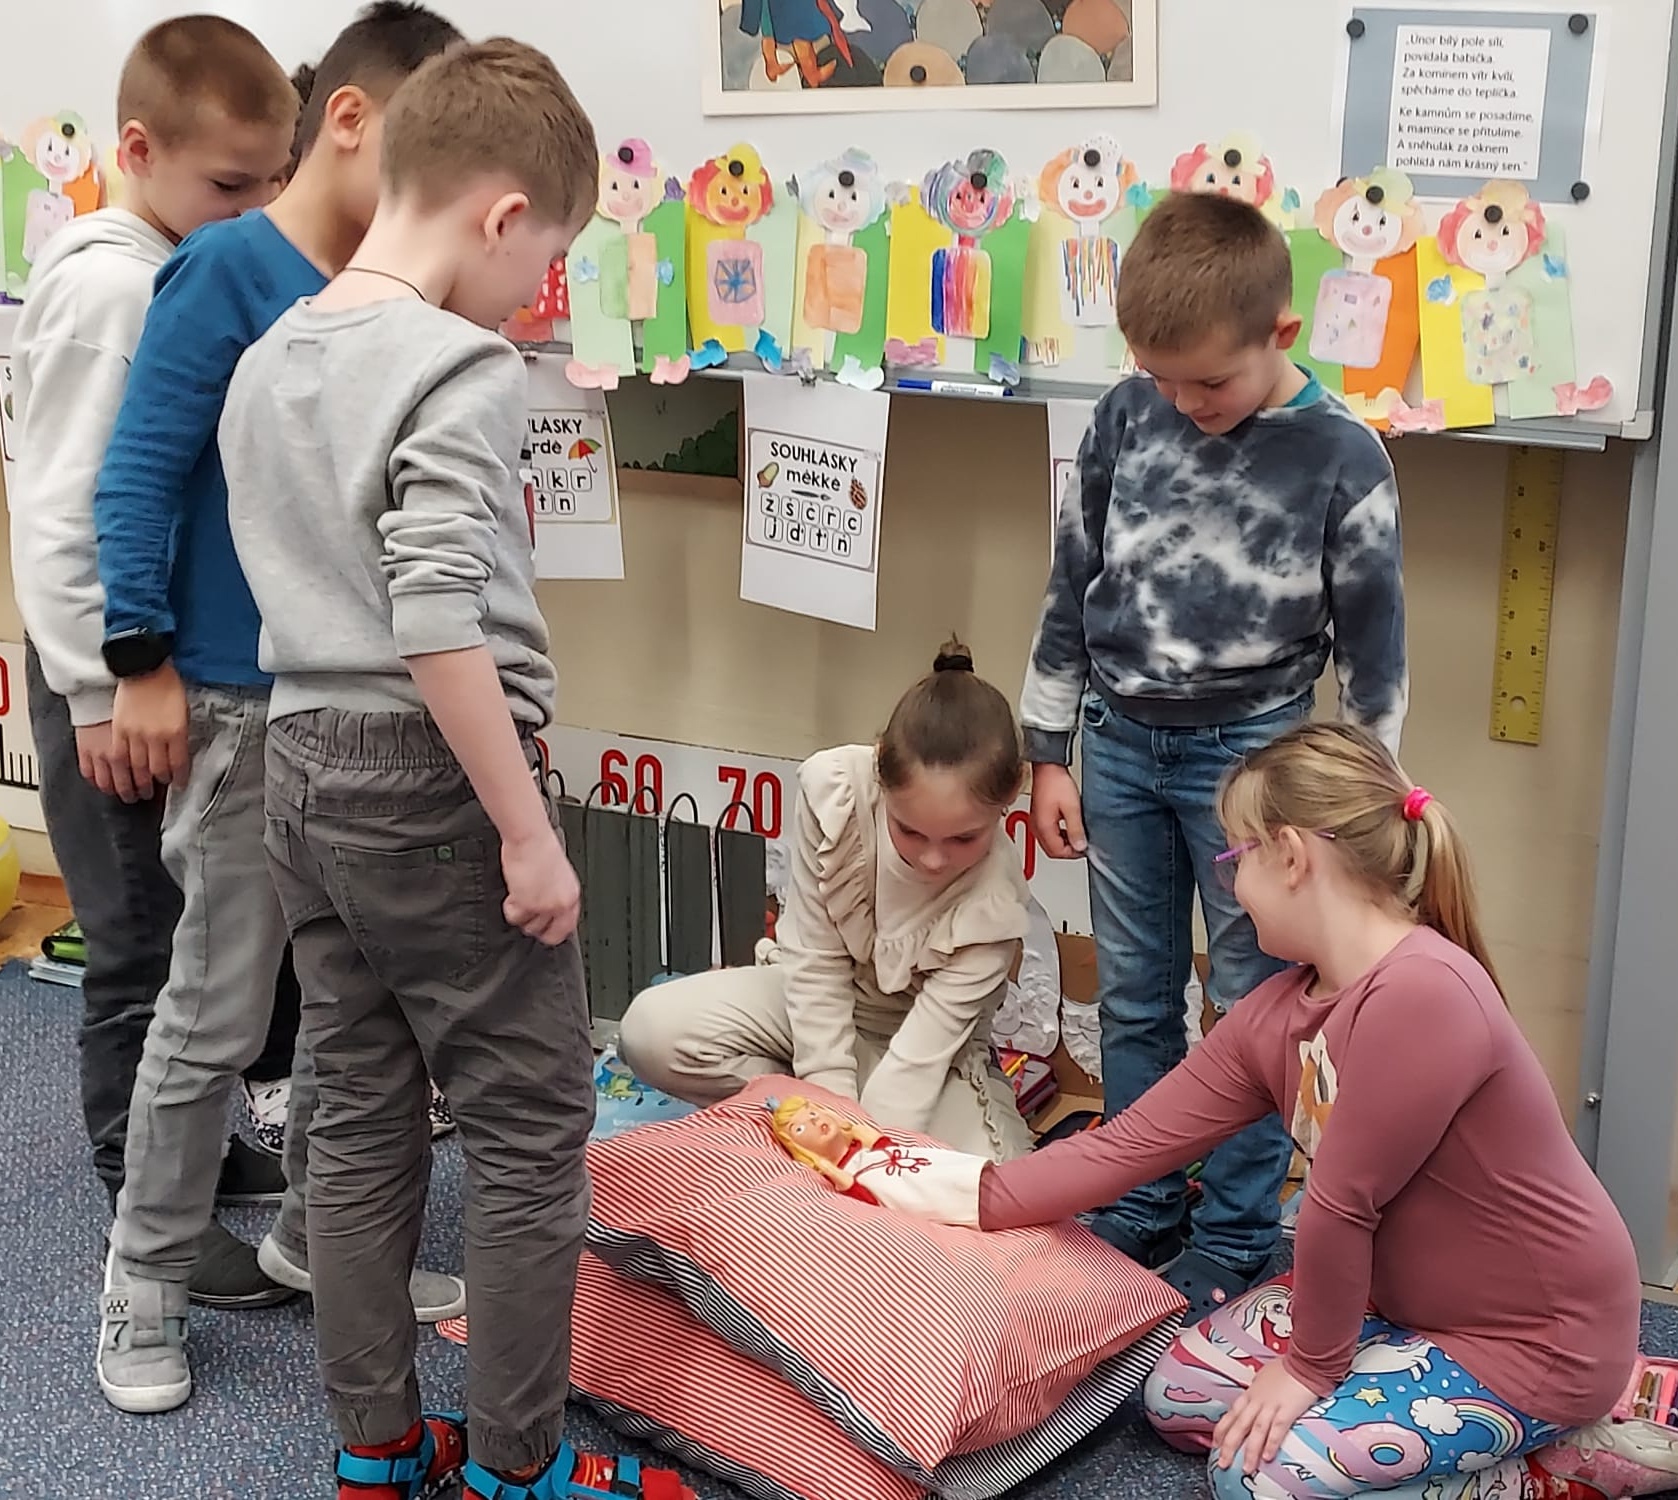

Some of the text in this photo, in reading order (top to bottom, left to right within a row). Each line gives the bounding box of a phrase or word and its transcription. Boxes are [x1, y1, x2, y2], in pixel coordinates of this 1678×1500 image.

[1461, 35, 1485, 49] pole
[1402, 66, 1416, 79] Za
[1401, 84, 1455, 97] spěcháme
[1457, 86, 1472, 97] do
[1398, 106, 1413, 117] Ke
[1415, 106, 1461, 119] kamnům
[1464, 111, 1477, 120] se
[1397, 122, 1404, 133] k
[1406, 124, 1456, 136] mamince
[1458, 127, 1470, 136] se
[1396, 138, 1509, 154] A sněhulák za oknem
[1438, 158, 1462, 169] nám
[1464, 159, 1500, 173] krásný
[770, 440, 858, 474] SOUHLÁSKY
[552, 471, 564, 488] k
[577, 475, 587, 488] r
[786, 468, 841, 492] měkké
[538, 494, 571, 511] t n
[768, 516, 777, 538] j
[847, 517, 857, 530] c
[601, 749, 662, 815] 60
[718, 766, 782, 839] 70
